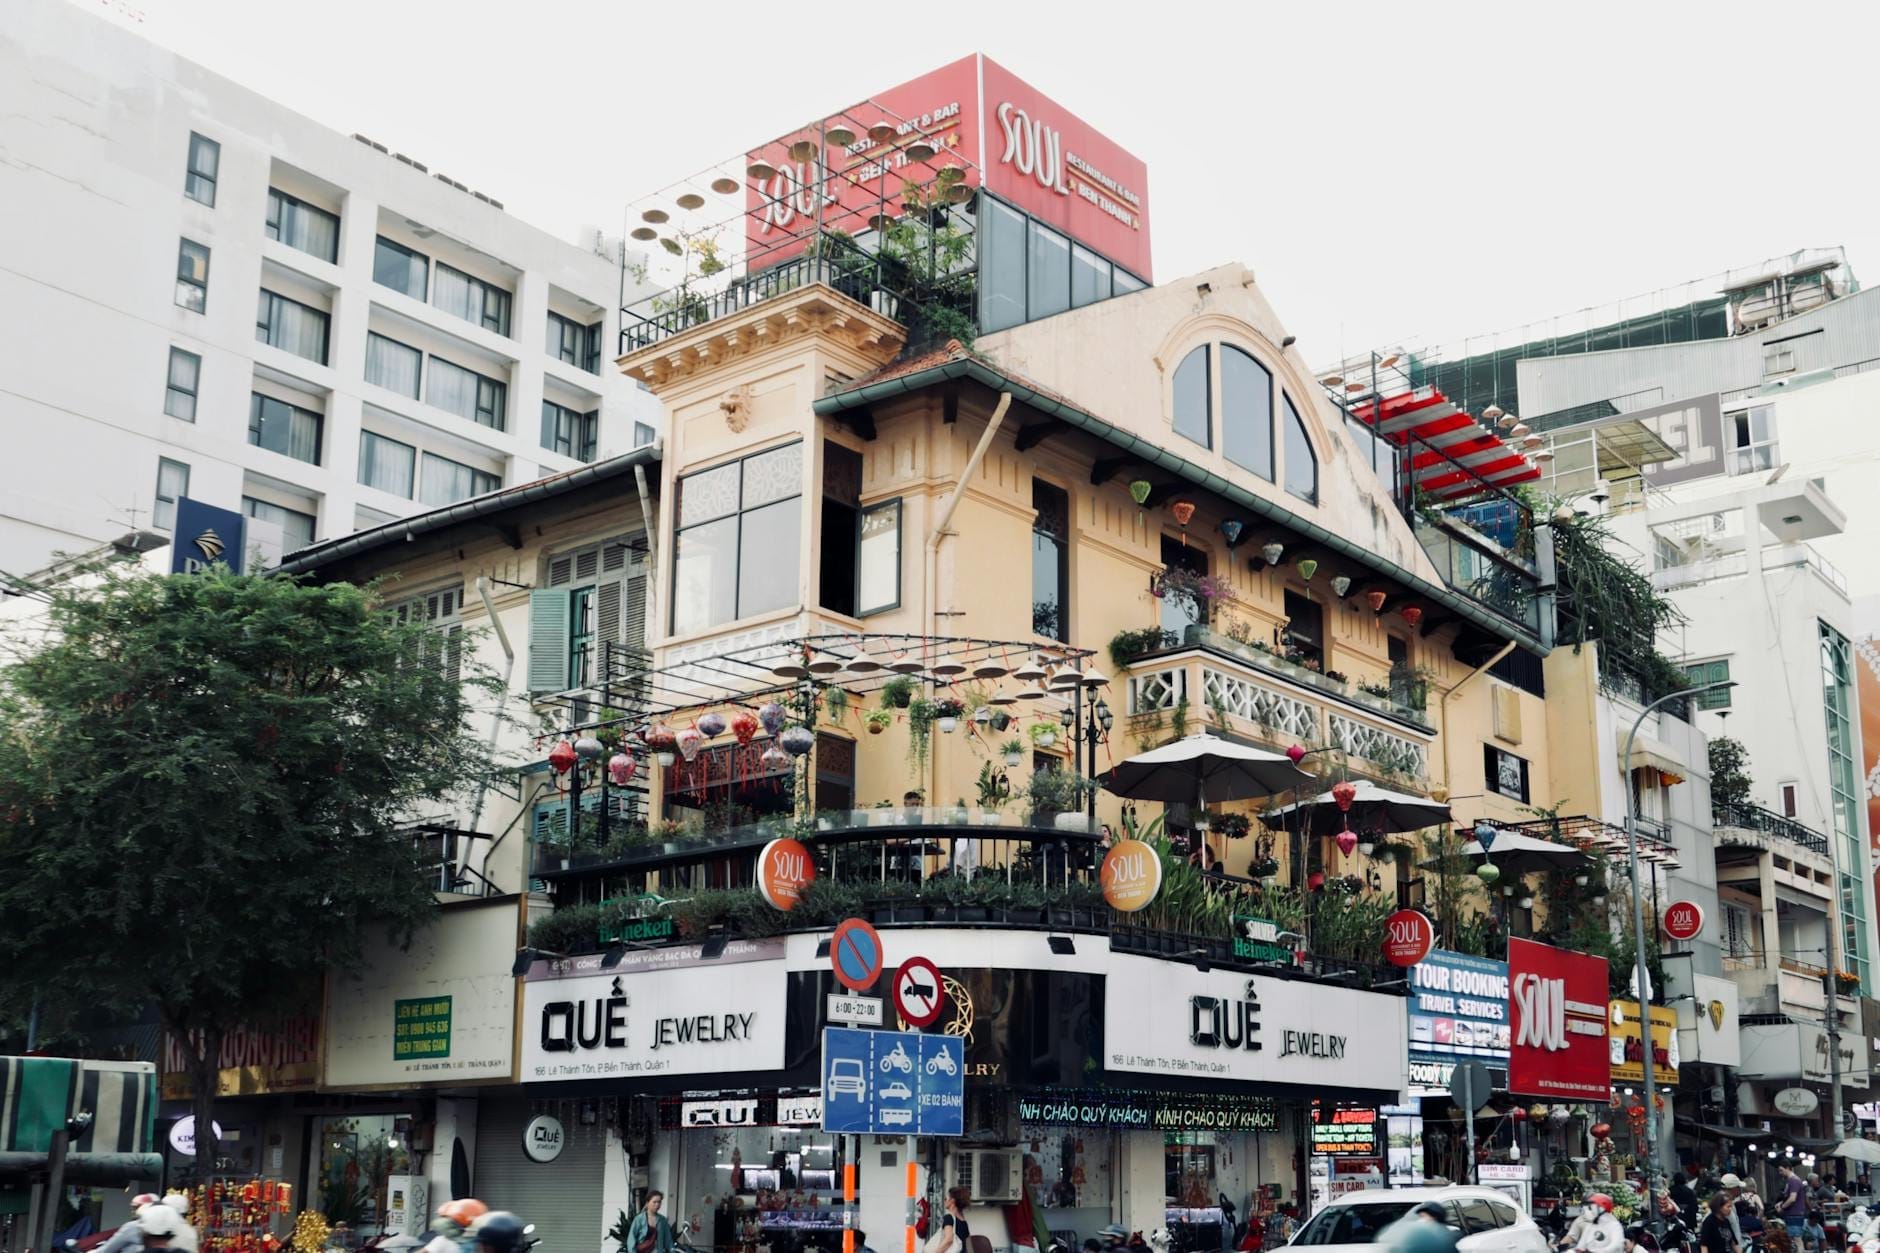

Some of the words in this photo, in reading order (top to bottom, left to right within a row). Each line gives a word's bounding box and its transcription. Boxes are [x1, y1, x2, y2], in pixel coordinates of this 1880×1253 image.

[933, 101, 960, 122] BAR
[997, 102, 1069, 196] SOUL
[757, 150, 838, 235] SOUL
[1077, 182, 1098, 206] BEN
[774, 850, 805, 882] SOUL
[1110, 852, 1147, 885] SOUL
[1672, 909, 1693, 924] SOUL
[1389, 919, 1422, 944] SOUL
[1234, 937, 1291, 963] Heineken
[1414, 962, 1449, 992] TOUR
[1453, 968, 1509, 999] BOOKING
[1419, 993, 1457, 1014] TRAVEL
[1458, 999, 1503, 1020] SERVICES
[1513, 972, 1571, 1052] SOUL
[651, 1012, 757, 1051] JEWELRY
[1278, 1028, 1348, 1060] JEWELRY
[921, 1094, 931, 1105] XE
[932, 1095, 941, 1105] 02
[942, 1092, 962, 1107] BÁNH
[1020, 1099, 1040, 1120] ÍNH
[1043, 1101, 1078, 1122] CHÀO
[1080, 1103, 1106, 1123] QUÝ
[1108, 1104, 1148, 1124] KHÁCH
[690, 1107, 757, 1125] QU
[782, 1108, 821, 1122] JEW
[1155, 1108, 1182, 1126] KÍNH
[1185, 1108, 1215, 1127] CHÀO
[1216, 1110, 1239, 1128] QUÝ
[1240, 1109, 1275, 1127] KHÁCH
[1481, 1165, 1498, 1173] SIM
[1331, 1182, 1344, 1193] SIM
[1346, 1181, 1365, 1192] CARD
